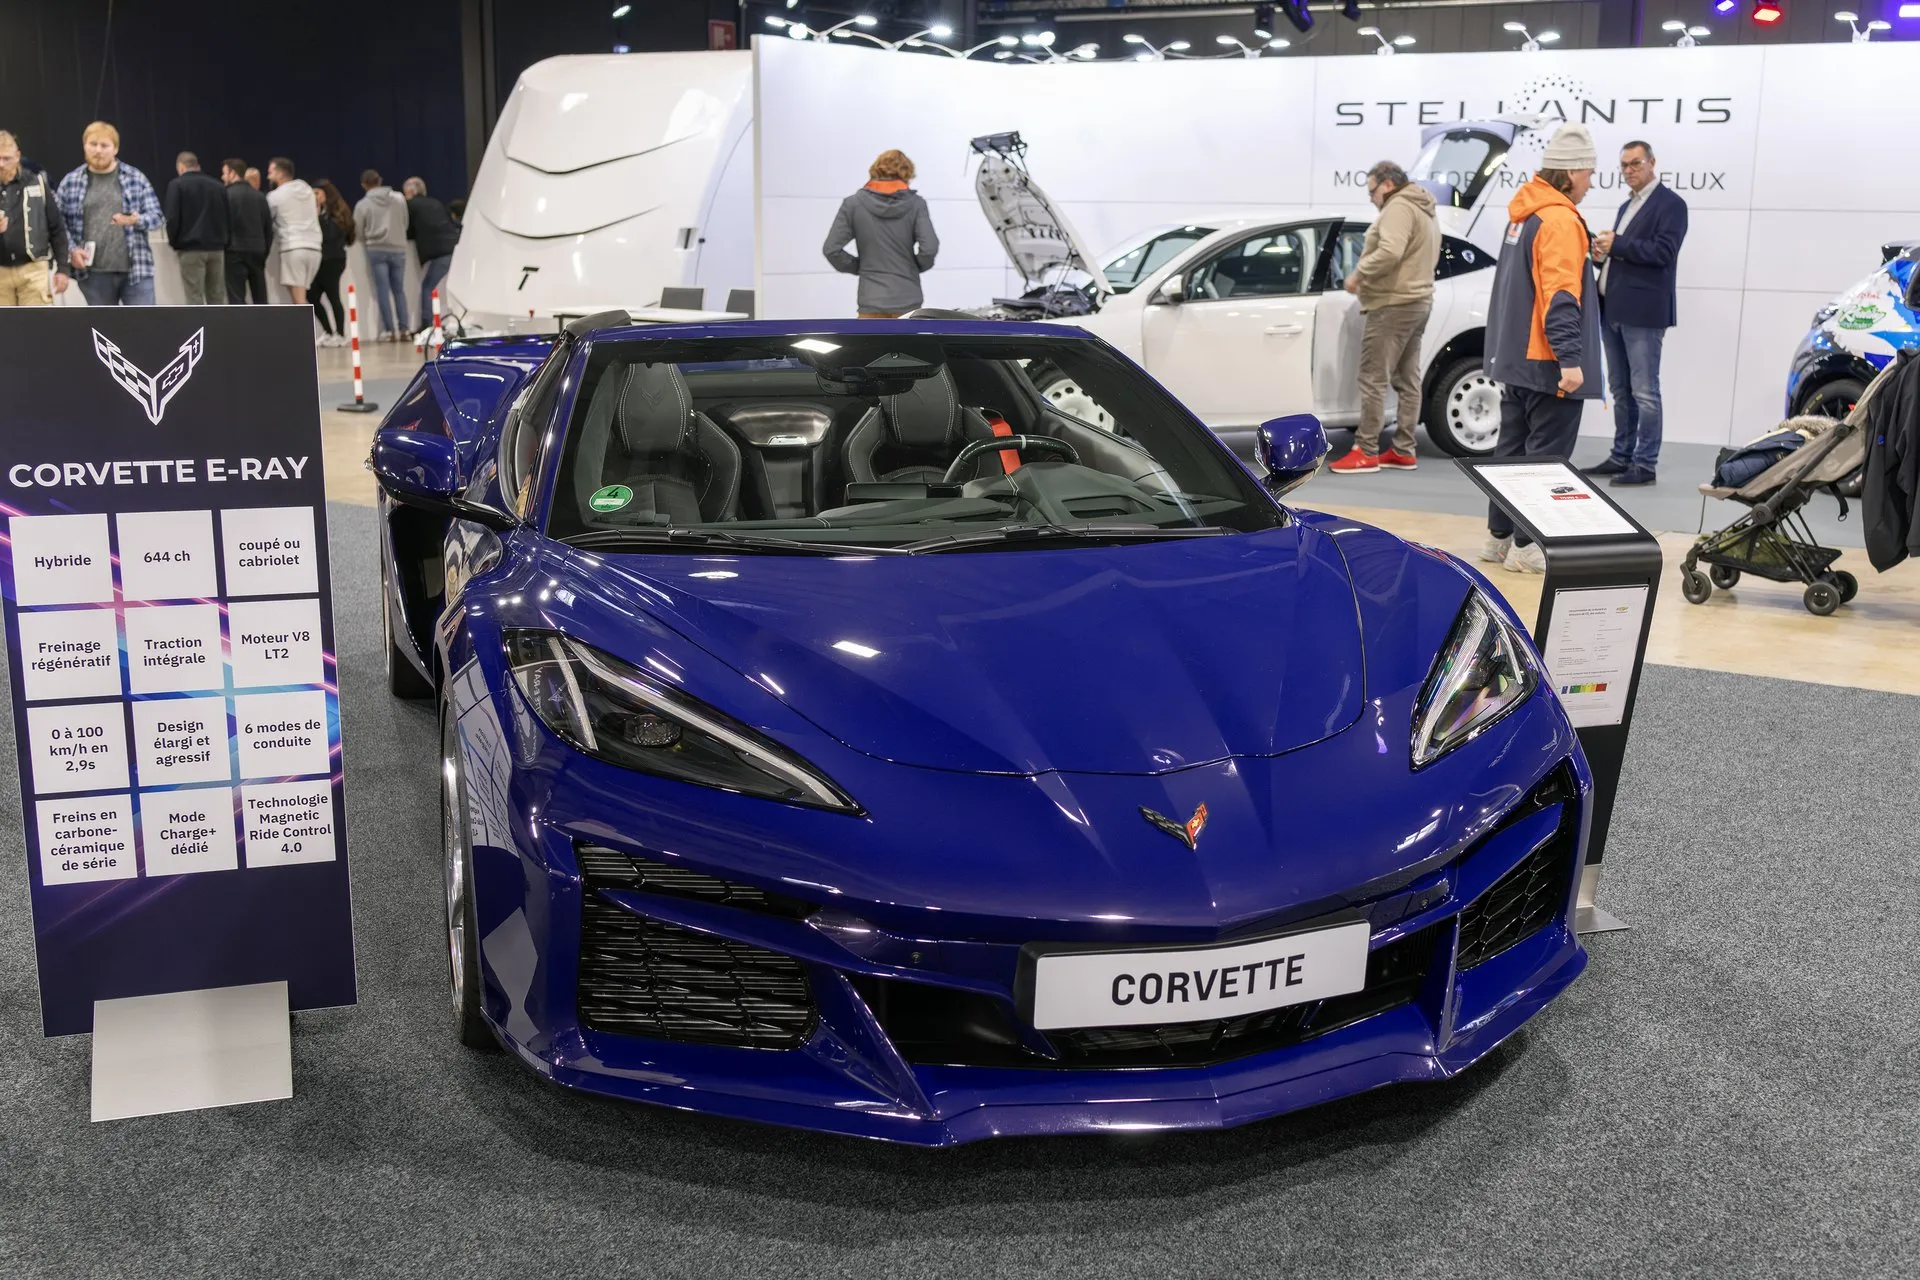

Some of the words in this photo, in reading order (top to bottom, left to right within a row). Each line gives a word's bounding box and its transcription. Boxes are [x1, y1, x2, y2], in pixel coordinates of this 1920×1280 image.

[1335, 97, 1732, 126] STEANTIS
[1659, 171, 1726, 191] ELUX
[8, 459, 197, 488] CORVETTE
[206, 456, 309, 482] E-RAY
[605, 485, 621, 499] 4
[238, 537, 281, 553] coupé
[283, 540, 300, 549] ou
[34, 554, 92, 570] Hybride
[143, 551, 171, 563] 644
[174, 550, 191, 562] ch
[238, 554, 300, 568] cabriolet
[143, 636, 202, 650] Traction
[241, 633, 289, 645] Moteur
[291, 630, 310, 642] V8
[38, 640, 102, 656] Freinage
[264, 648, 289, 660] LT2
[31, 655, 112, 672] régénératif
[143, 652, 206, 668] intégrale
[51, 729, 61, 740] 0
[64, 727, 73, 740] à
[76, 726, 104, 739] 100
[157, 719, 205, 736] Design
[244, 723, 253, 734] 6
[256, 720, 301, 734] modes
[304, 719, 321, 730] de
[49, 743, 88, 757] km/h
[91, 744, 109, 754] en
[153, 736, 194, 752] élargi
[196, 735, 211, 747] et
[253, 735, 312, 750] conduite
[65, 759, 96, 773] 2,9s
[155, 750, 211, 768] agressif
[247, 793, 329, 811] Technologie
[52, 810, 97, 824] Freins
[100, 810, 117, 820] en
[168, 810, 206, 824] Mode
[259, 809, 320, 826] Magnetic
[54, 826, 118, 840] carbone-
[159, 827, 218, 843] Charge+
[249, 828, 281, 842] Ride
[282, 823, 333, 839] Control
[50, 841, 126, 858] céramique
[170, 840, 209, 856] dédié
[280, 842, 303, 854] 4.0
[61, 859, 79, 871] de
[82, 856, 117, 870] série
[1110, 953, 1306, 1007] CORVETTE
